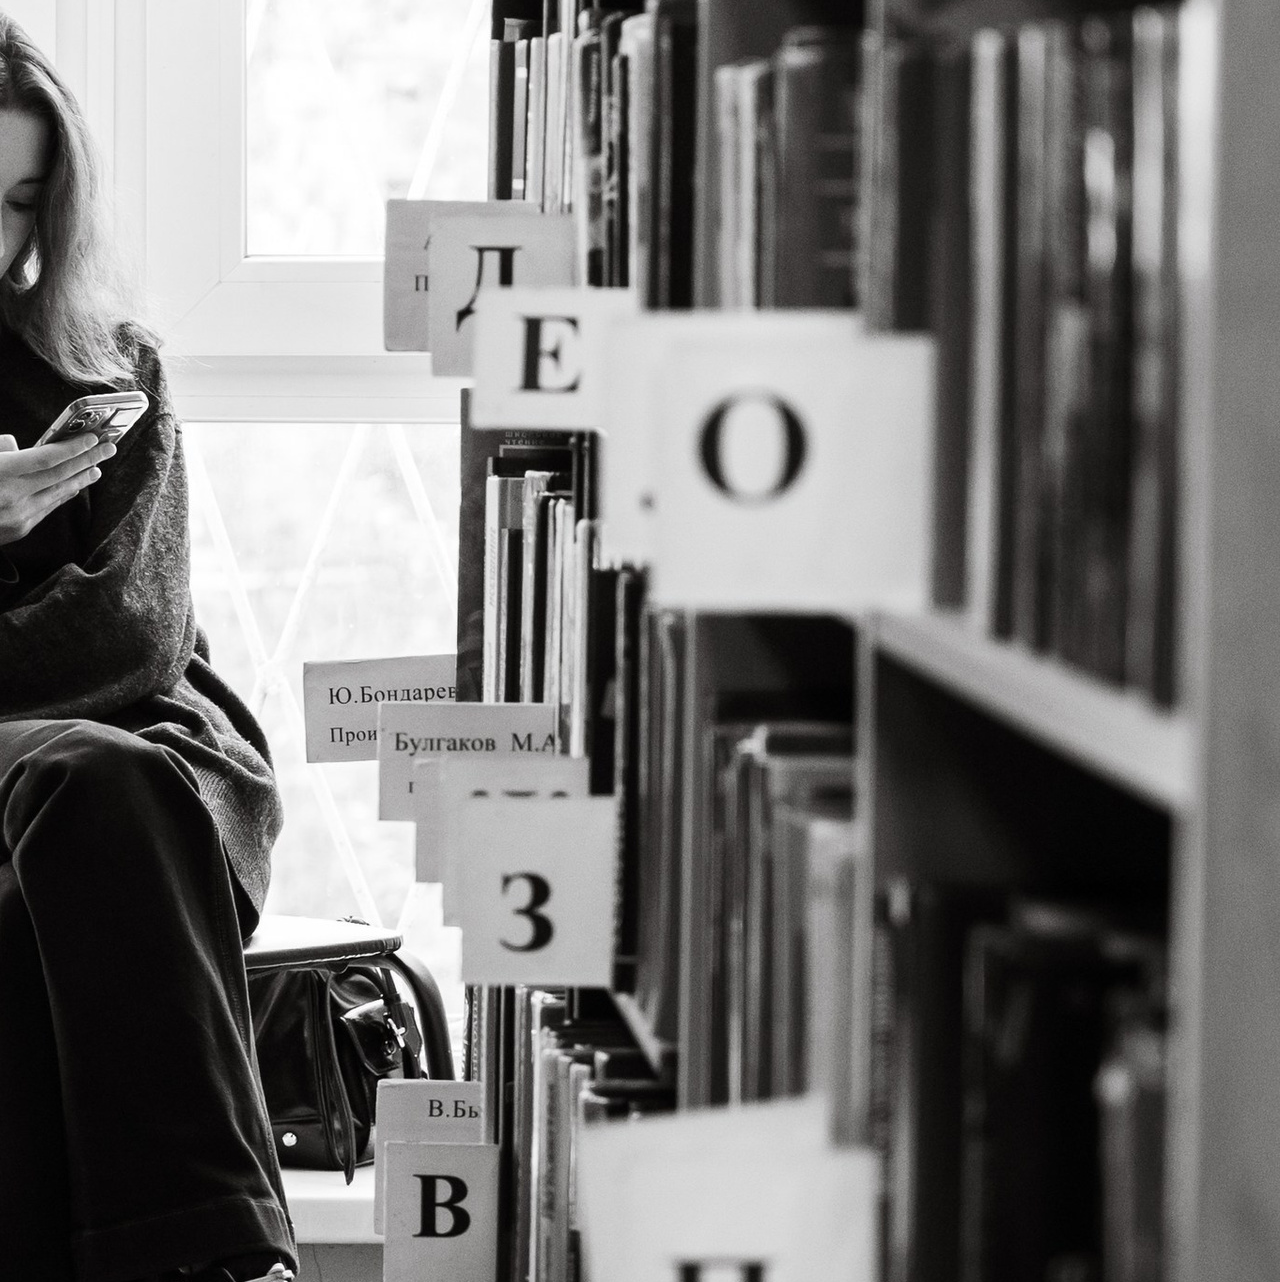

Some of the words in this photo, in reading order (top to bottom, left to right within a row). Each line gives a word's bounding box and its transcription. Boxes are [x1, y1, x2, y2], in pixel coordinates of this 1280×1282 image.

[518, 315, 582, 394] Е
[696, 391, 808, 506] О
[328, 685, 456, 705] Ю.Бондарев
[394, 732, 497, 757] Булгаков
[412, 1174, 471, 1238] В
